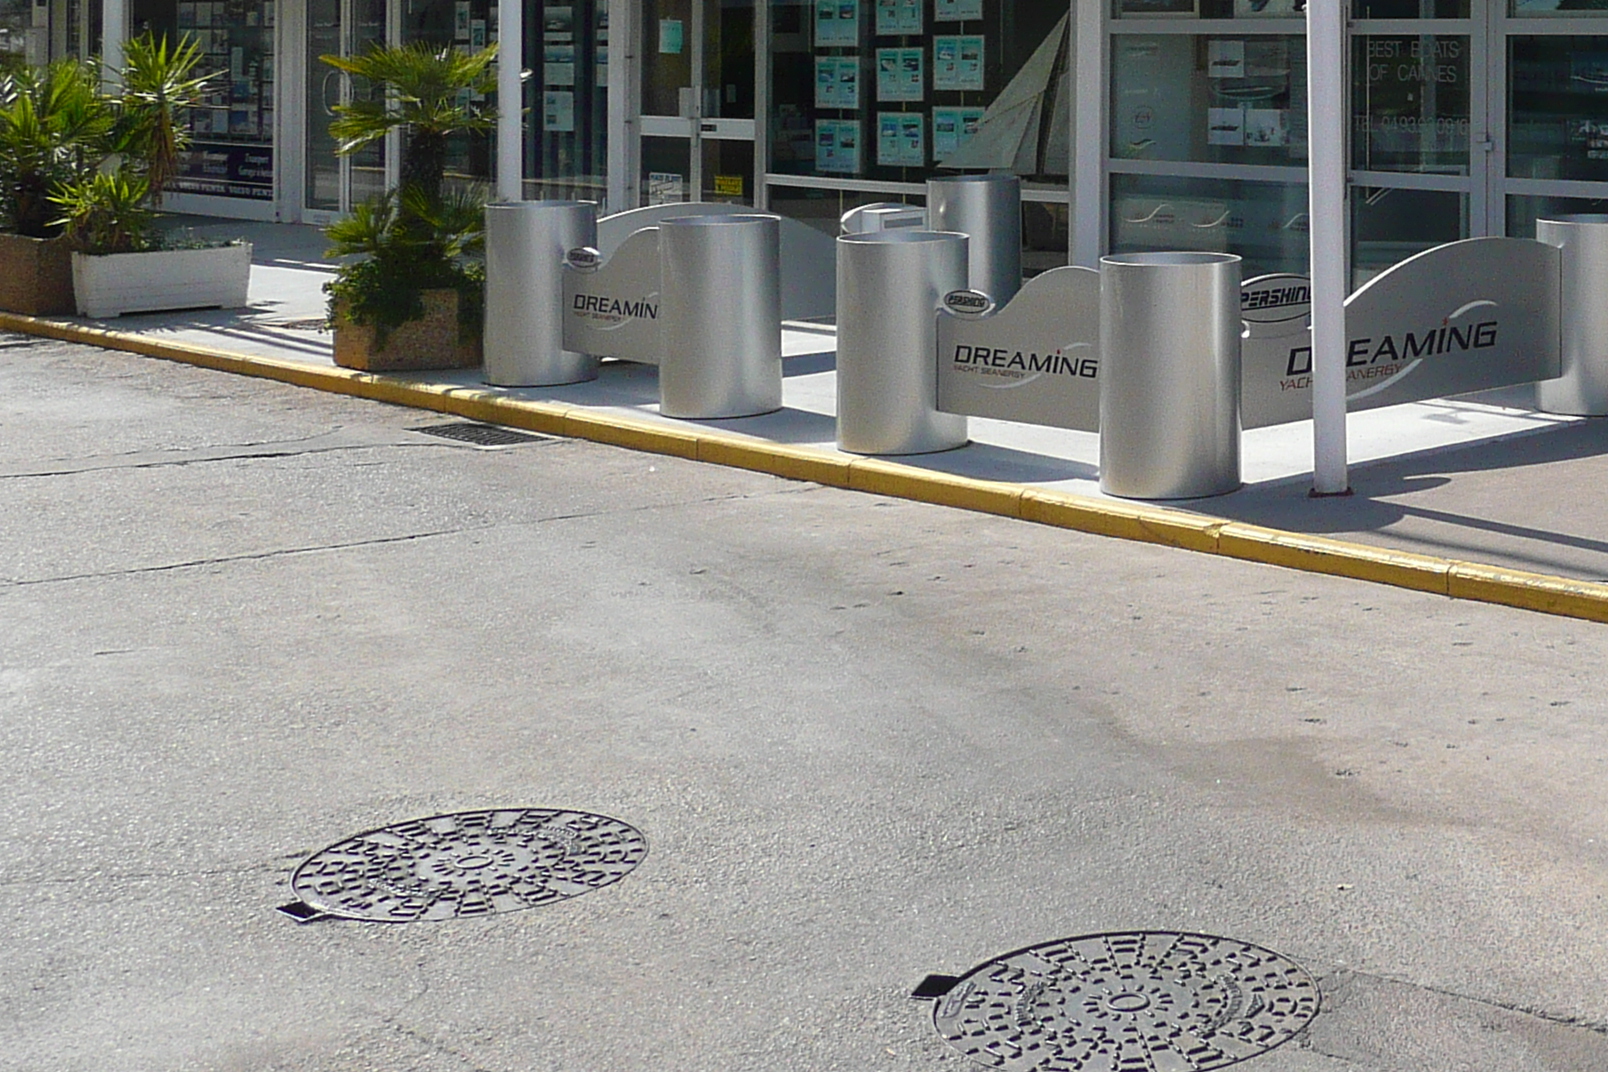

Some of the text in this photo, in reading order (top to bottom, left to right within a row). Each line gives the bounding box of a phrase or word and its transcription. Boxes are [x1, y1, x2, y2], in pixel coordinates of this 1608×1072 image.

[573, 294, 658, 320] DREAMIN
[954, 344, 1099, 379] DREAMING
[1286, 319, 1498, 377] DEAMING
[1279, 362, 1402, 392] YACH ANERGY
